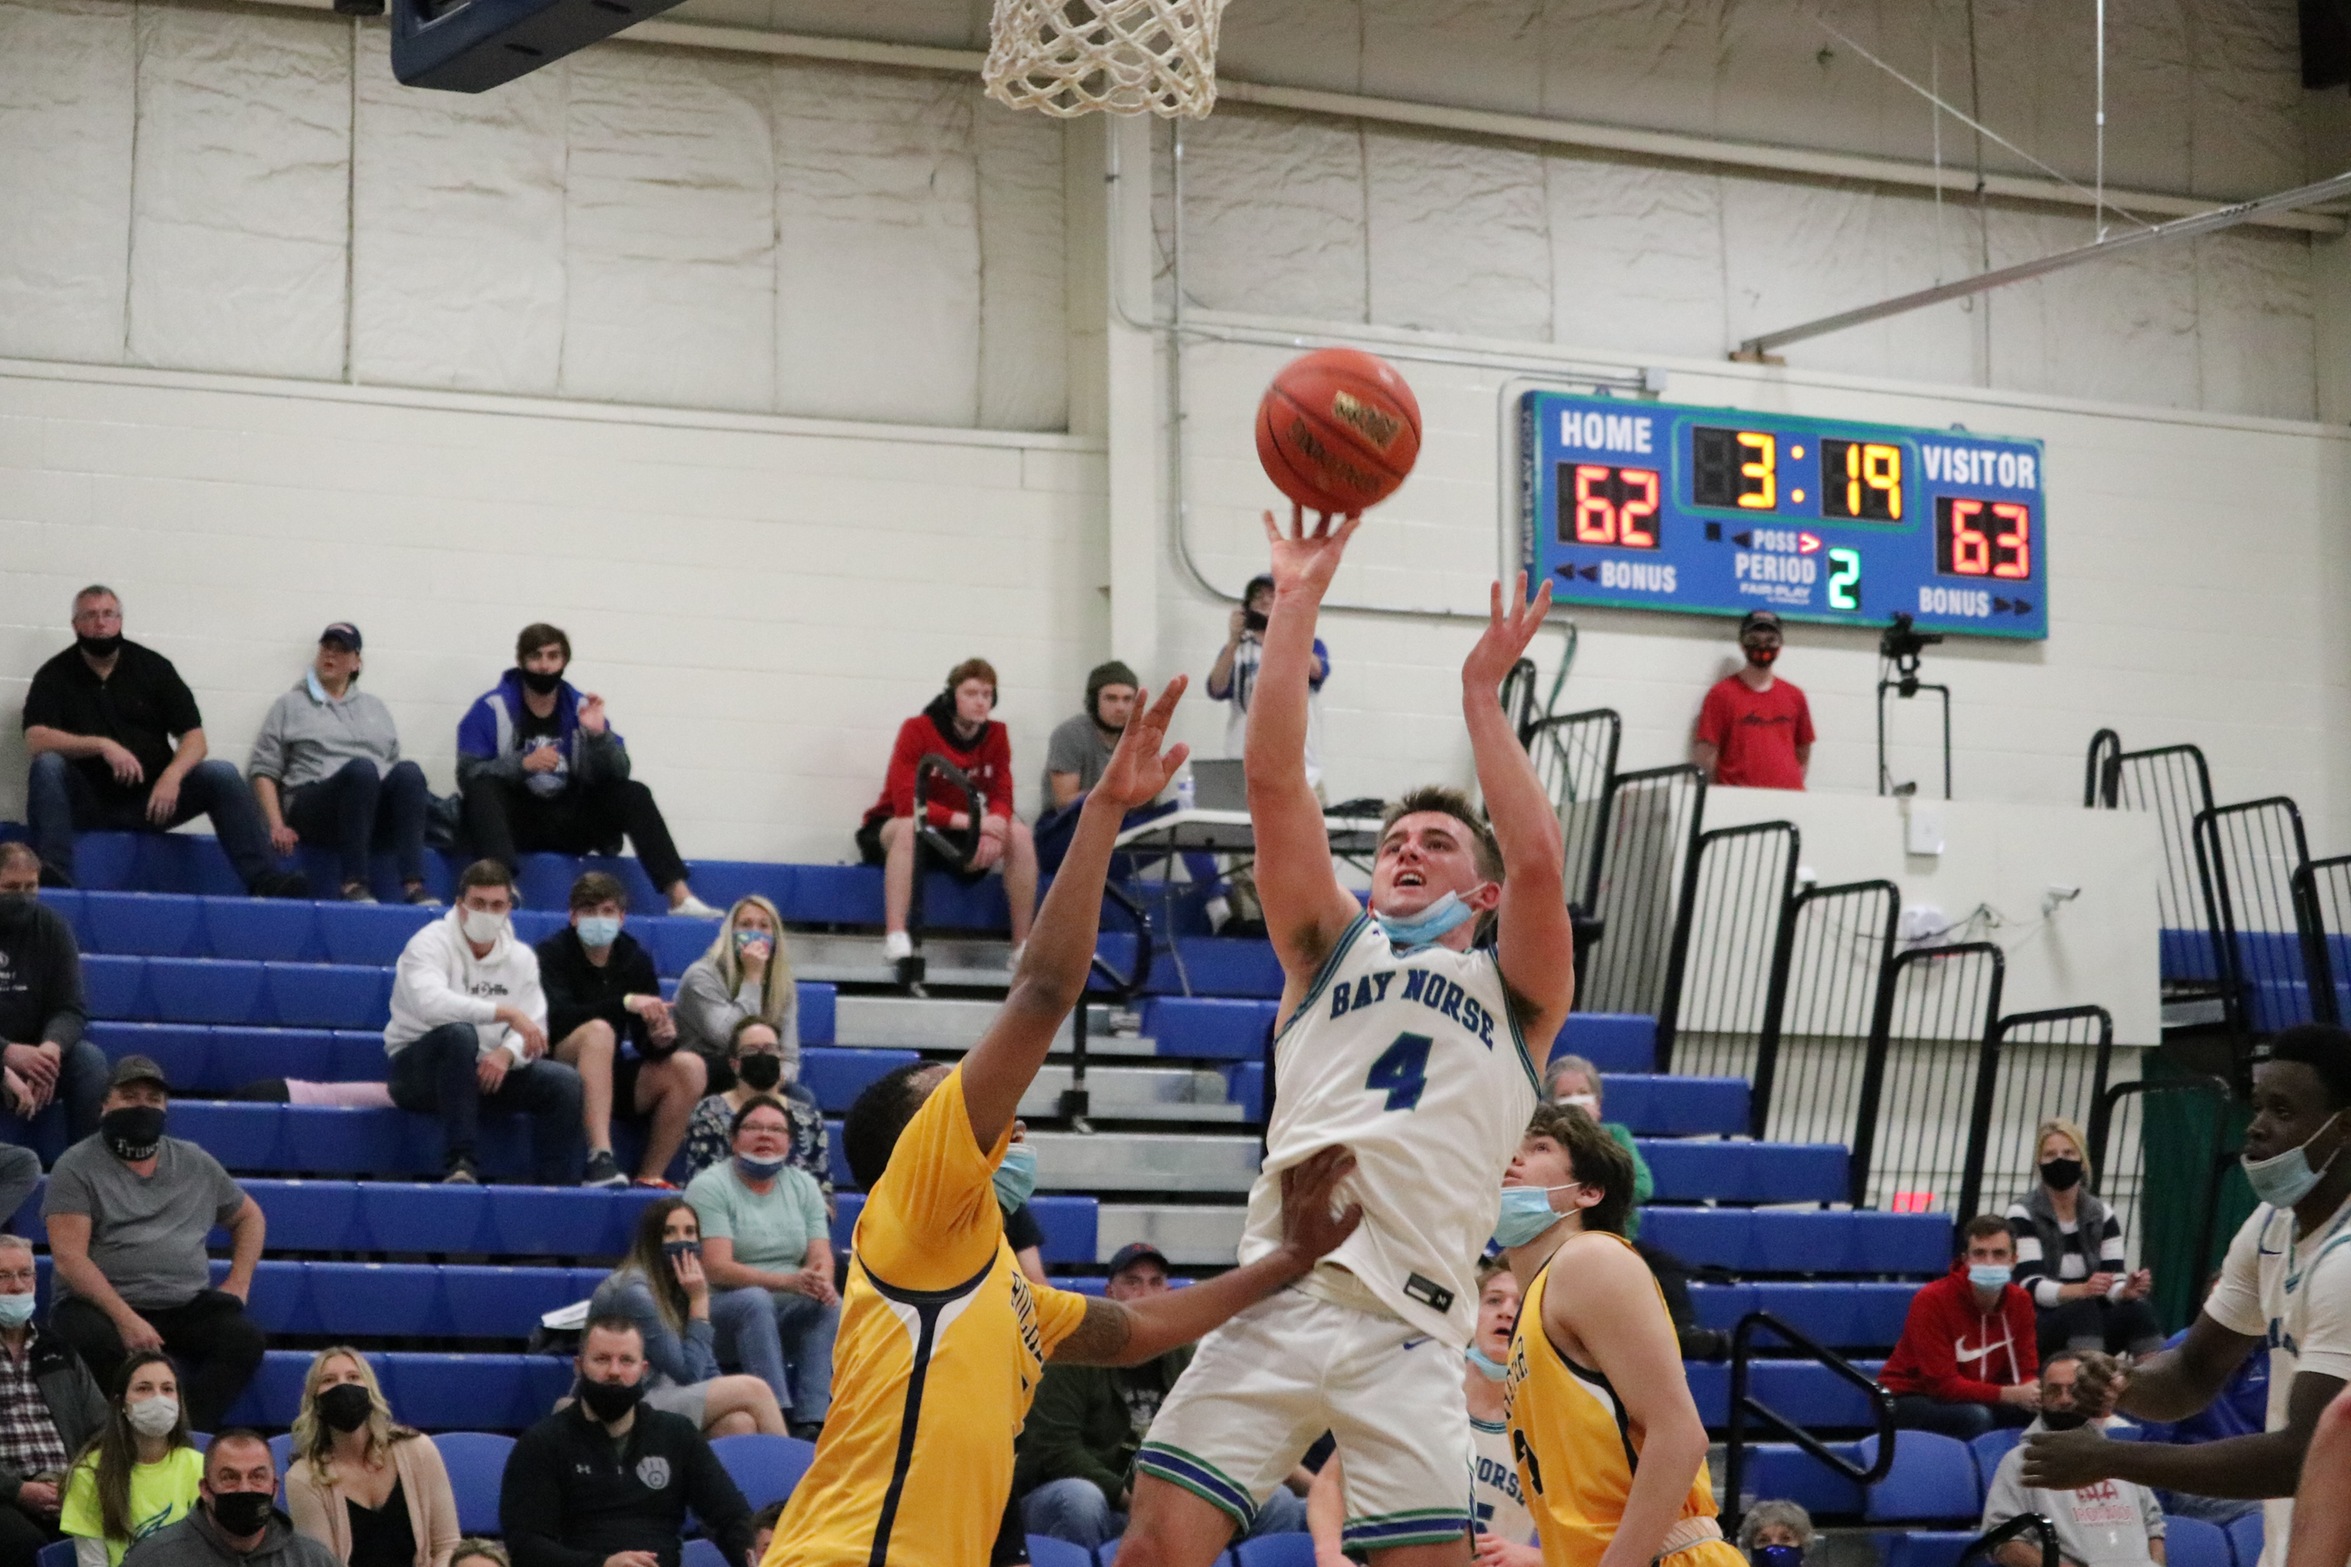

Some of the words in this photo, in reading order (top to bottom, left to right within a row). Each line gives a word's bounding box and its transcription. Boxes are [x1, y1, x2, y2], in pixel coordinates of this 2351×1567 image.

[1561, 410, 1653, 453] HOME
[1922, 444, 2036, 490] VISITOR
[1575, 464, 1660, 547] 62
[1753, 529, 1797, 552] POSS
[1952, 500, 2029, 578] 63
[1600, 560, 1677, 593] BONUS
[1735, 552, 1817, 584] PERIOD
[1828, 547, 1861, 610] 2
[1919, 587, 1990, 618] BONUS
[1330, 970, 1397, 1021] BAY
[1401, 968, 1495, 1052] NORSE
[1365, 1030, 1434, 1112] 4
